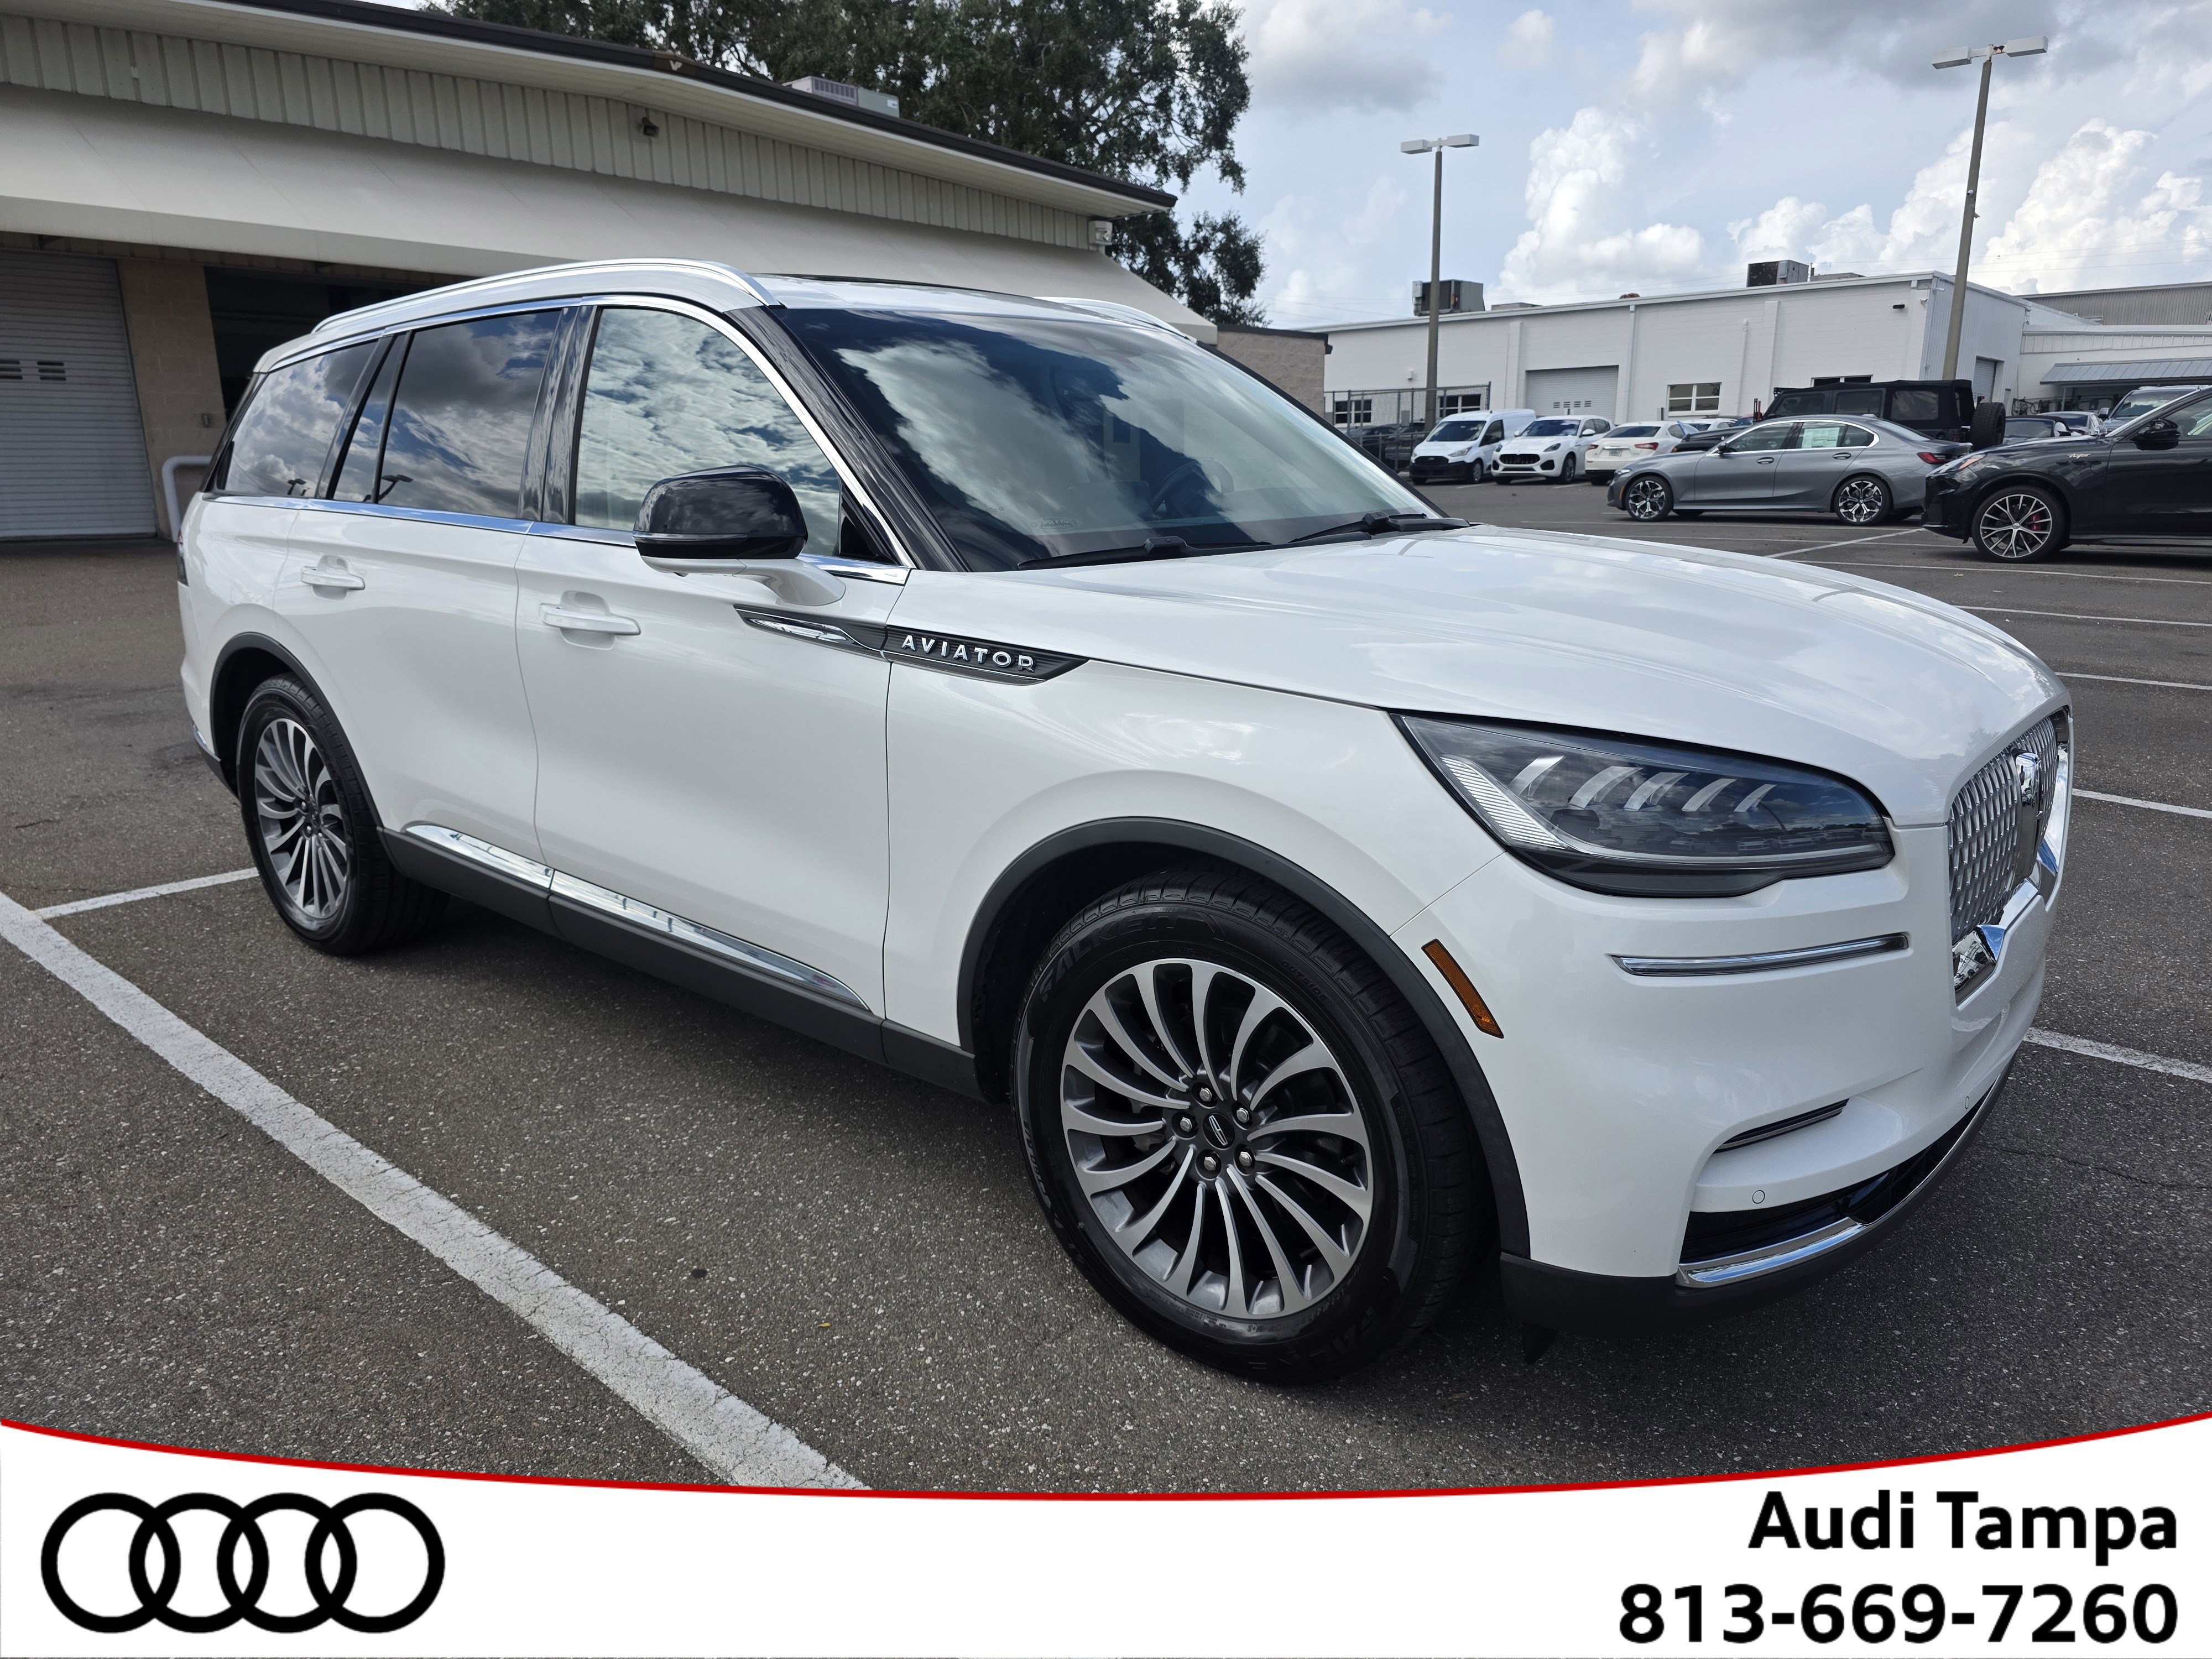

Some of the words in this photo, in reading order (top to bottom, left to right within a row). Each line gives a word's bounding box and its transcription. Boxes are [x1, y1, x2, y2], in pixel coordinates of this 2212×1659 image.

[901, 634, 1035, 673] AVIATOR
[1039, 910, 1178, 1003] FALKEN
[1280, 959, 1328, 1001] OUTSIDE
